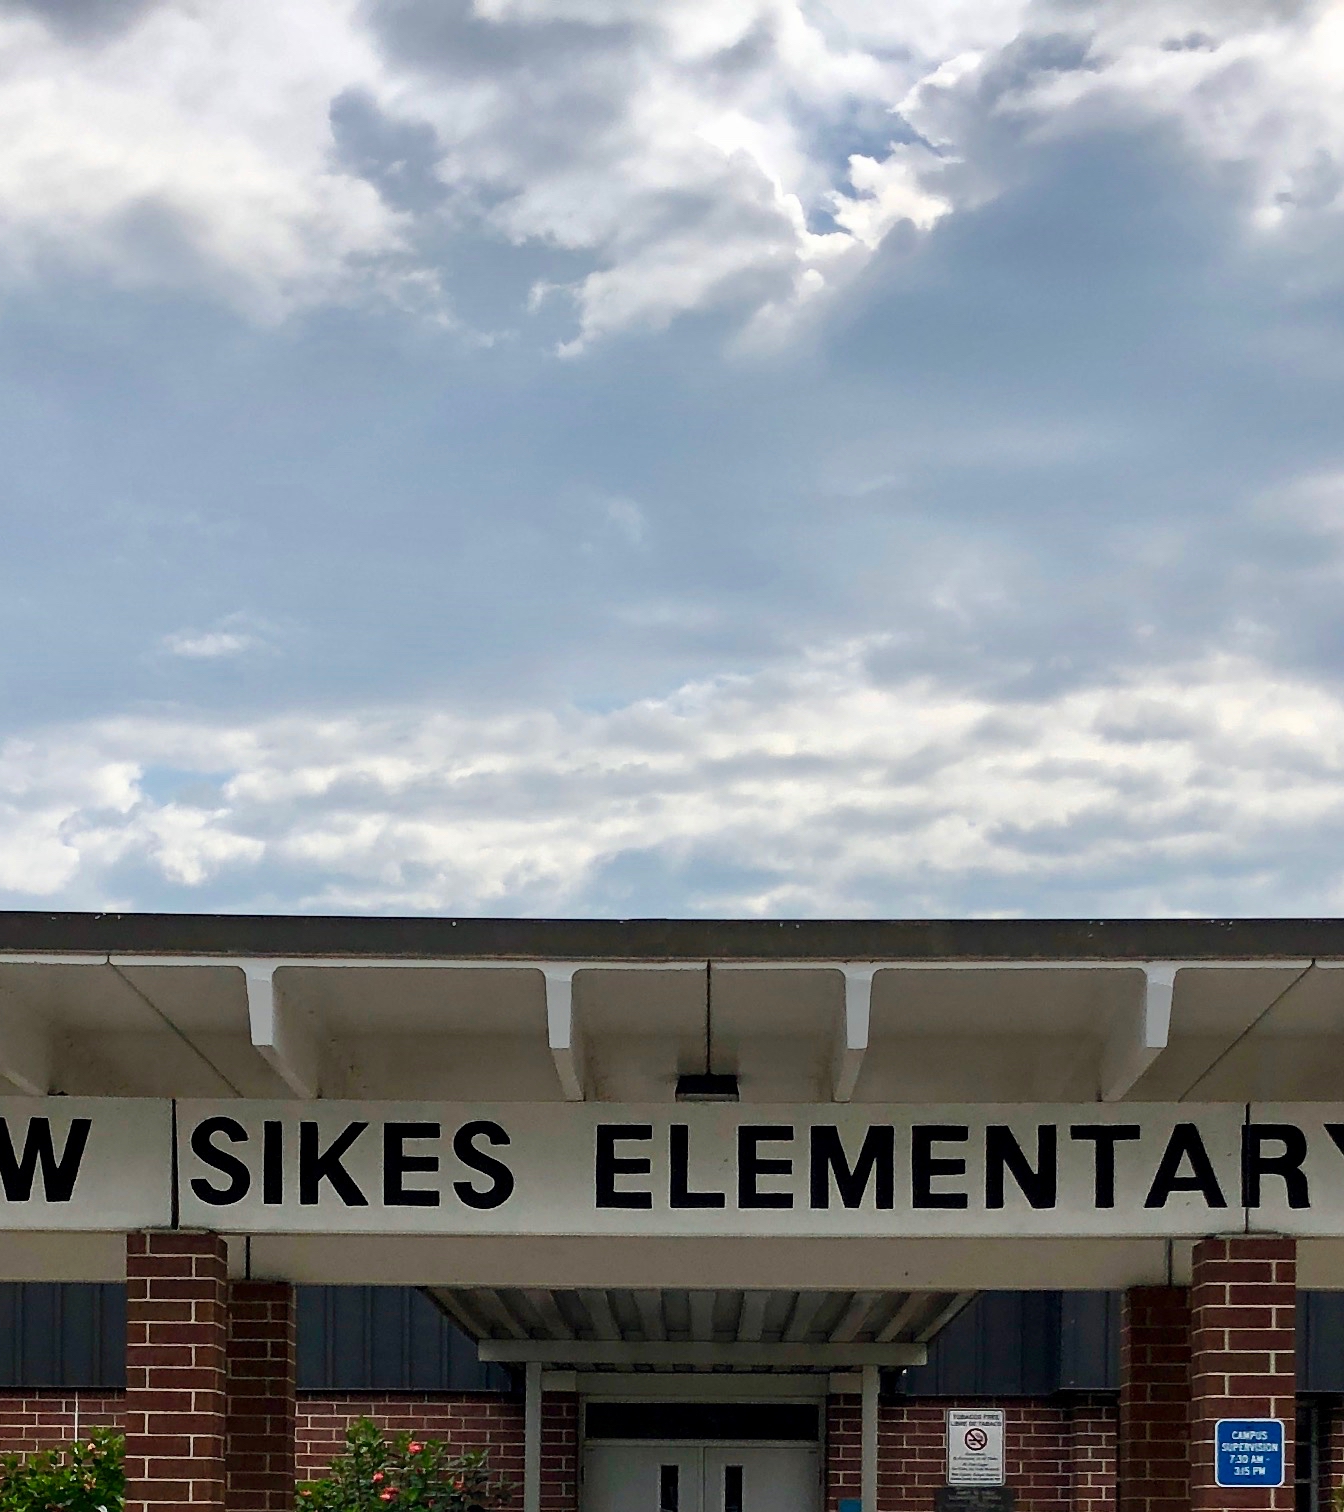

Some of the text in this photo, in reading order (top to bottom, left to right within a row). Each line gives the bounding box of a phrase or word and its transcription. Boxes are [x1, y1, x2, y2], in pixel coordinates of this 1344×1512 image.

[190, 1116, 514, 1210] SIKES
[1232, 1431, 1268, 1440] CAMPUS
[1221, 1443, 1278, 1452] SUPERVISION
[1251, 1455, 1264, 1463] AM
[1253, 1467, 1266, 1475] PM
